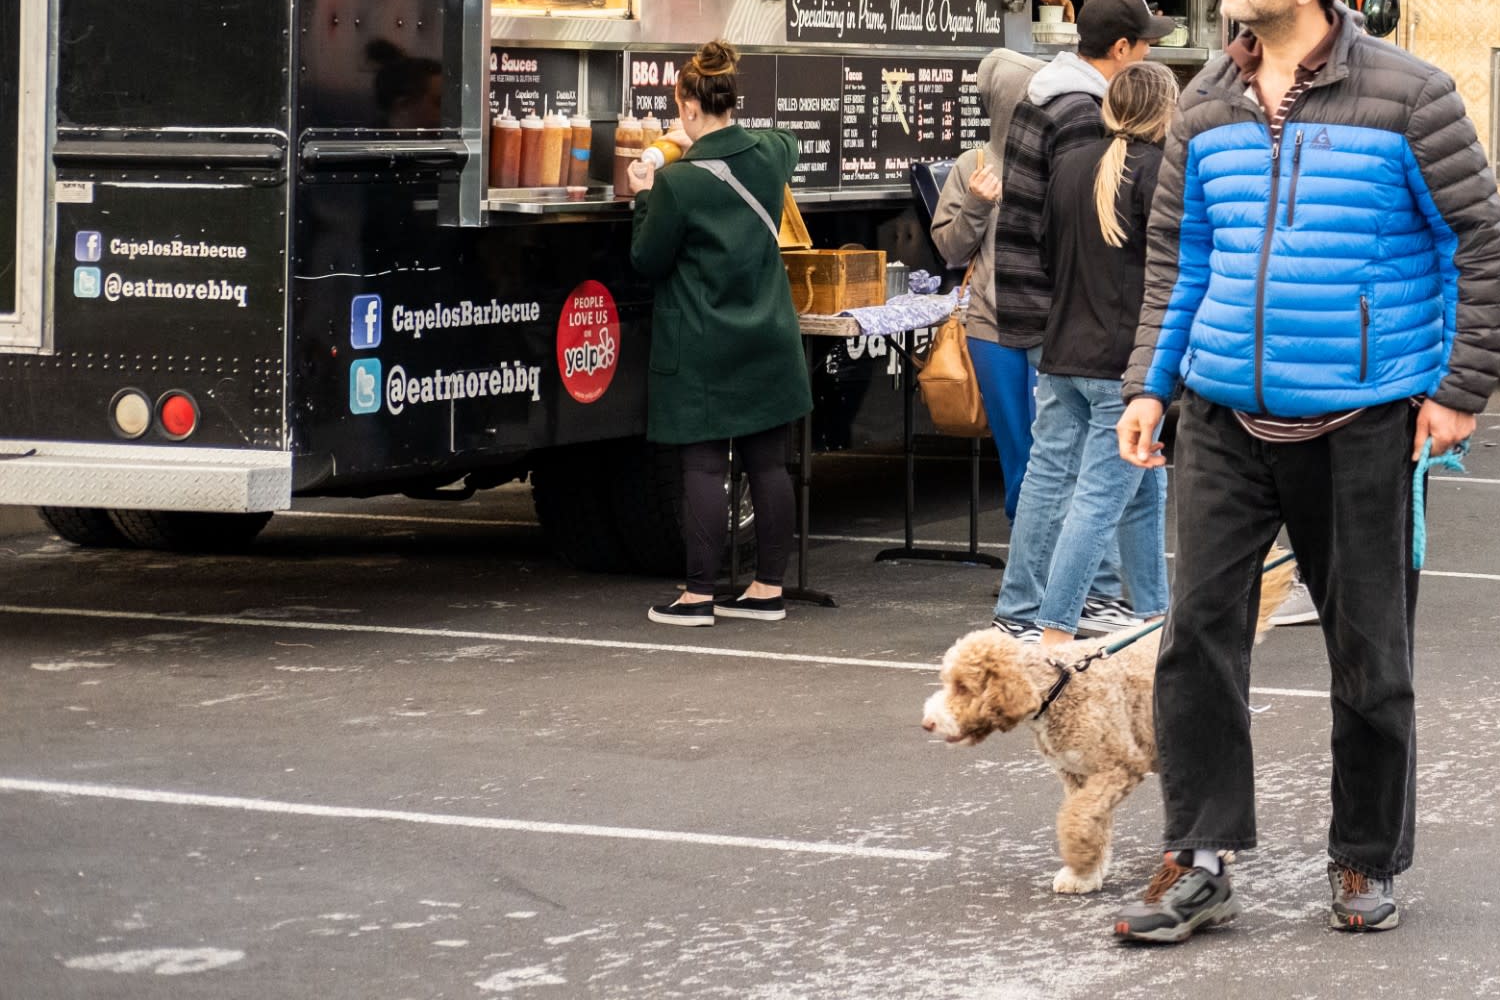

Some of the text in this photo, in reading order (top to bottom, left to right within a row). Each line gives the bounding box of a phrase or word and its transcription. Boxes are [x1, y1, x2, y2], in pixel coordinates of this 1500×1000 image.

[847, 2, 856, 29] in
[501, 52, 538, 73] Sauces
[632, 61, 659, 86] BBQ
[844, 67, 863, 81] Tacos
[918, 68, 932, 82] BBQ
[932, 68, 954, 82] PLATES
[961, 69, 978, 83] Meat
[636, 95, 668, 111] PORK RIBS
[777, 98, 840, 113] GRILLED CHICKEN BREAST
[803, 140, 814, 154] HOT
[814, 139, 831, 154] LINKS
[110, 238, 247, 260] CapelosBarbecue
[104, 272, 248, 308] @eatmorebbq
[573, 295, 604, 310] PEOPLE
[391, 299, 541, 339] CapelosBarbecue
[569, 309, 608, 327] LOVE US
[564, 340, 599, 378] yelp
[386, 360, 542, 416] @eatmorebbq
